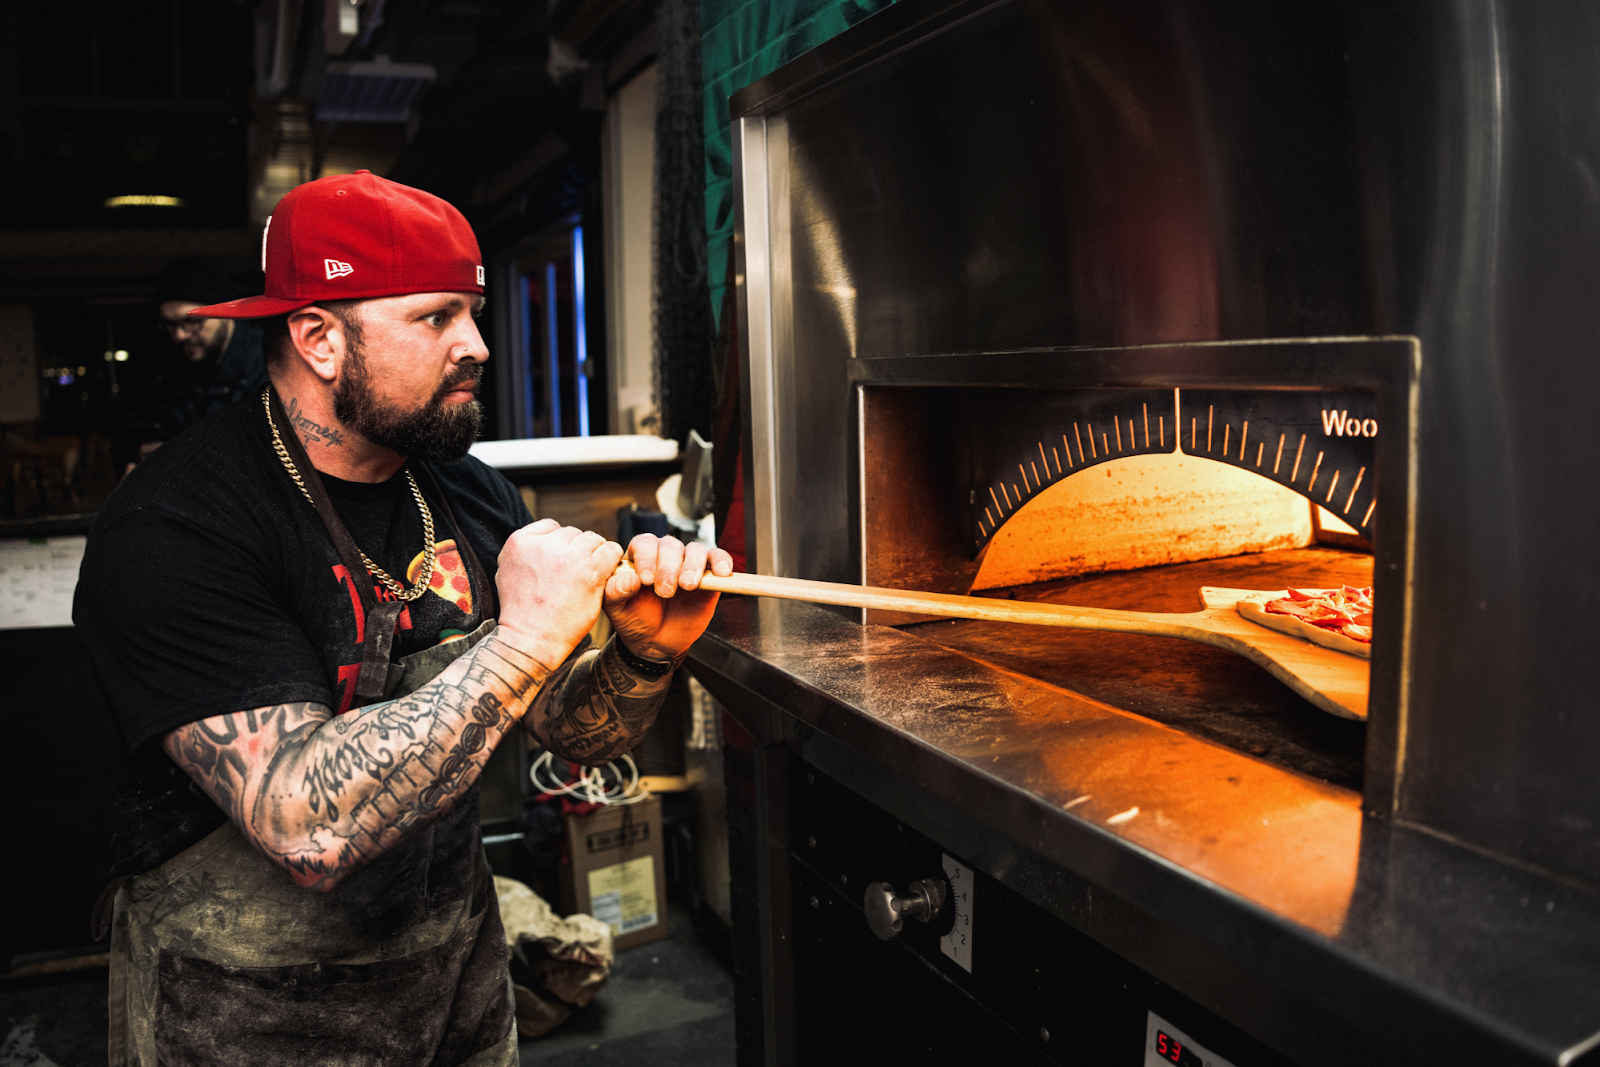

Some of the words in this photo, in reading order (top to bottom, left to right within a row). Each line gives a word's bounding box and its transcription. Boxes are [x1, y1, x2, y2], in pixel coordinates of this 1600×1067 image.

[1321, 409, 1379, 438] Woo
[955, 868, 960, 879] 5
[961, 892, 967, 902] 4
[964, 914, 969, 925] 3
[960, 934, 966, 945] 2
[953, 947, 957, 957] 1
[1157, 1032, 1183, 1063] 53
